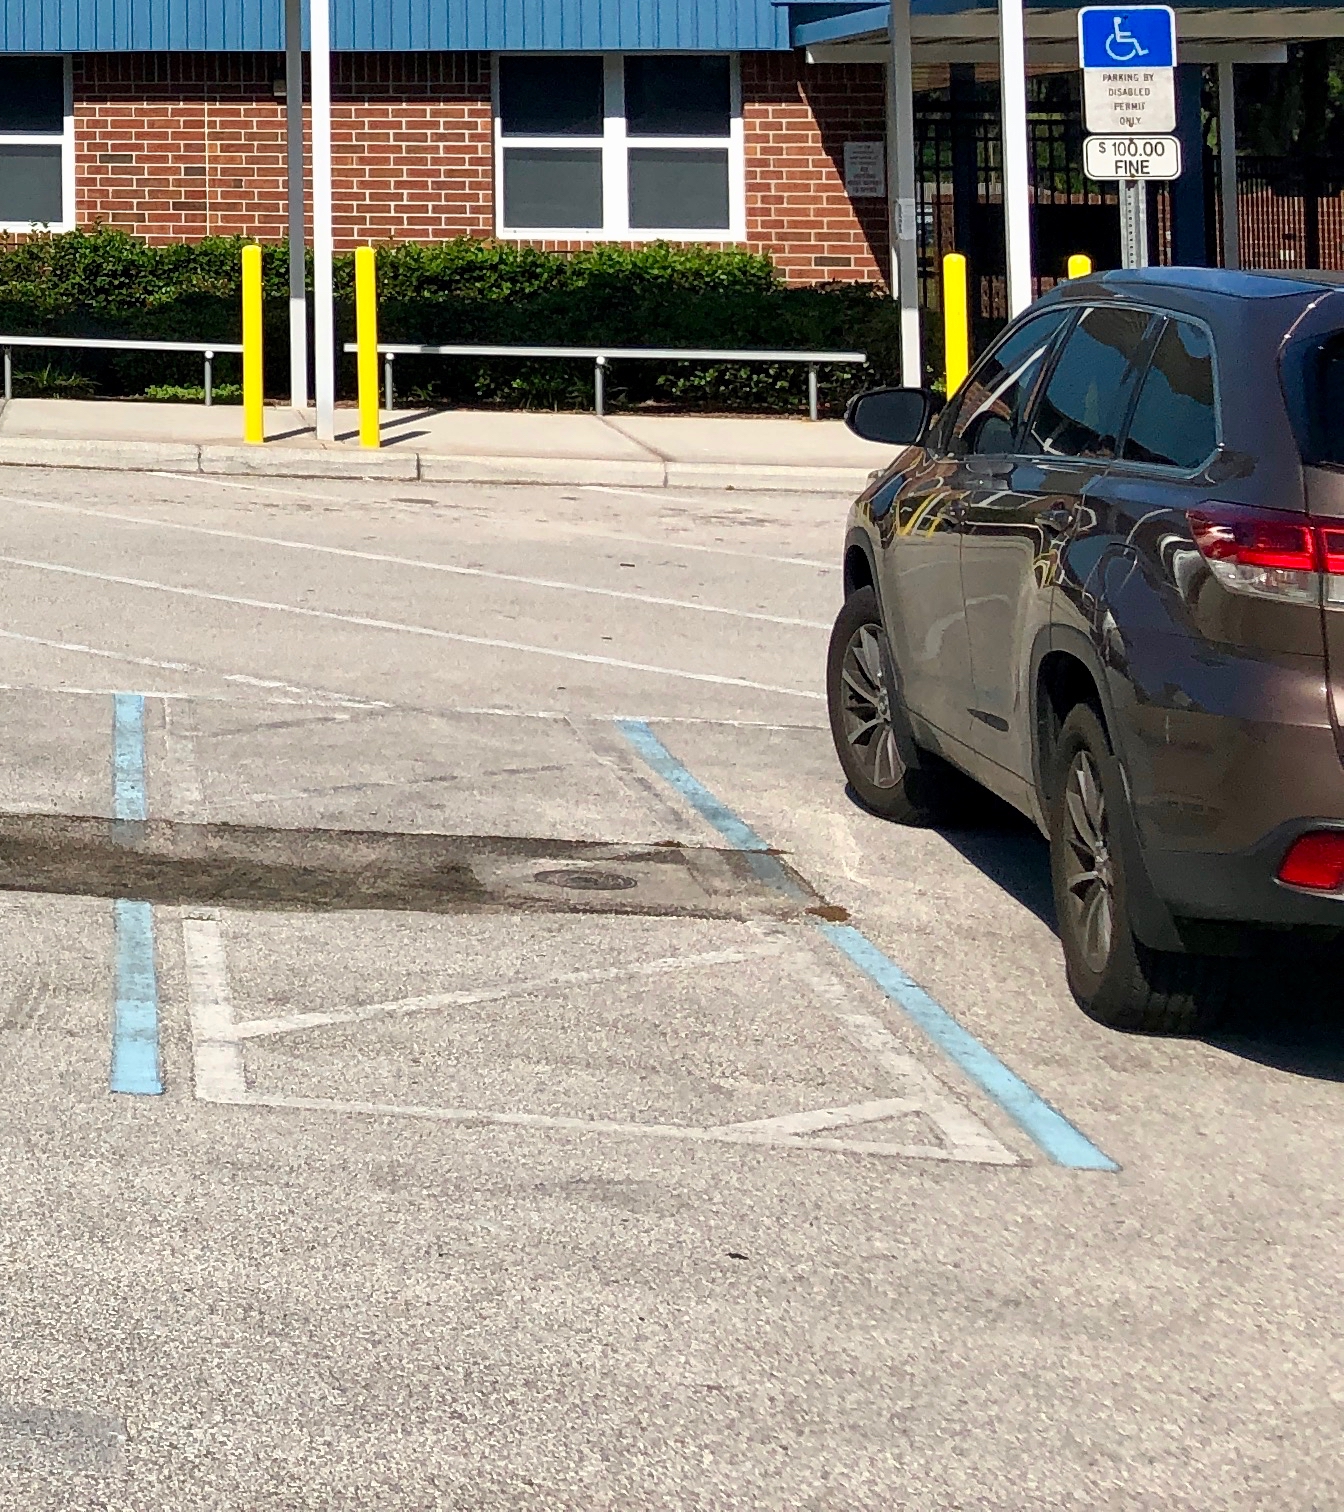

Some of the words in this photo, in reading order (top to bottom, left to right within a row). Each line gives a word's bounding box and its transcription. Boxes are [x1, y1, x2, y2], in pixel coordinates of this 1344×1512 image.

[1102, 73, 1139, 82] PARKING
[1143, 73, 1154, 81] BY
[1108, 88, 1151, 96] DISABLED
[1113, 102, 1146, 110] PERMIT
[1119, 117, 1141, 125] ONLY
[1115, 159, 1150, 175] FINE
